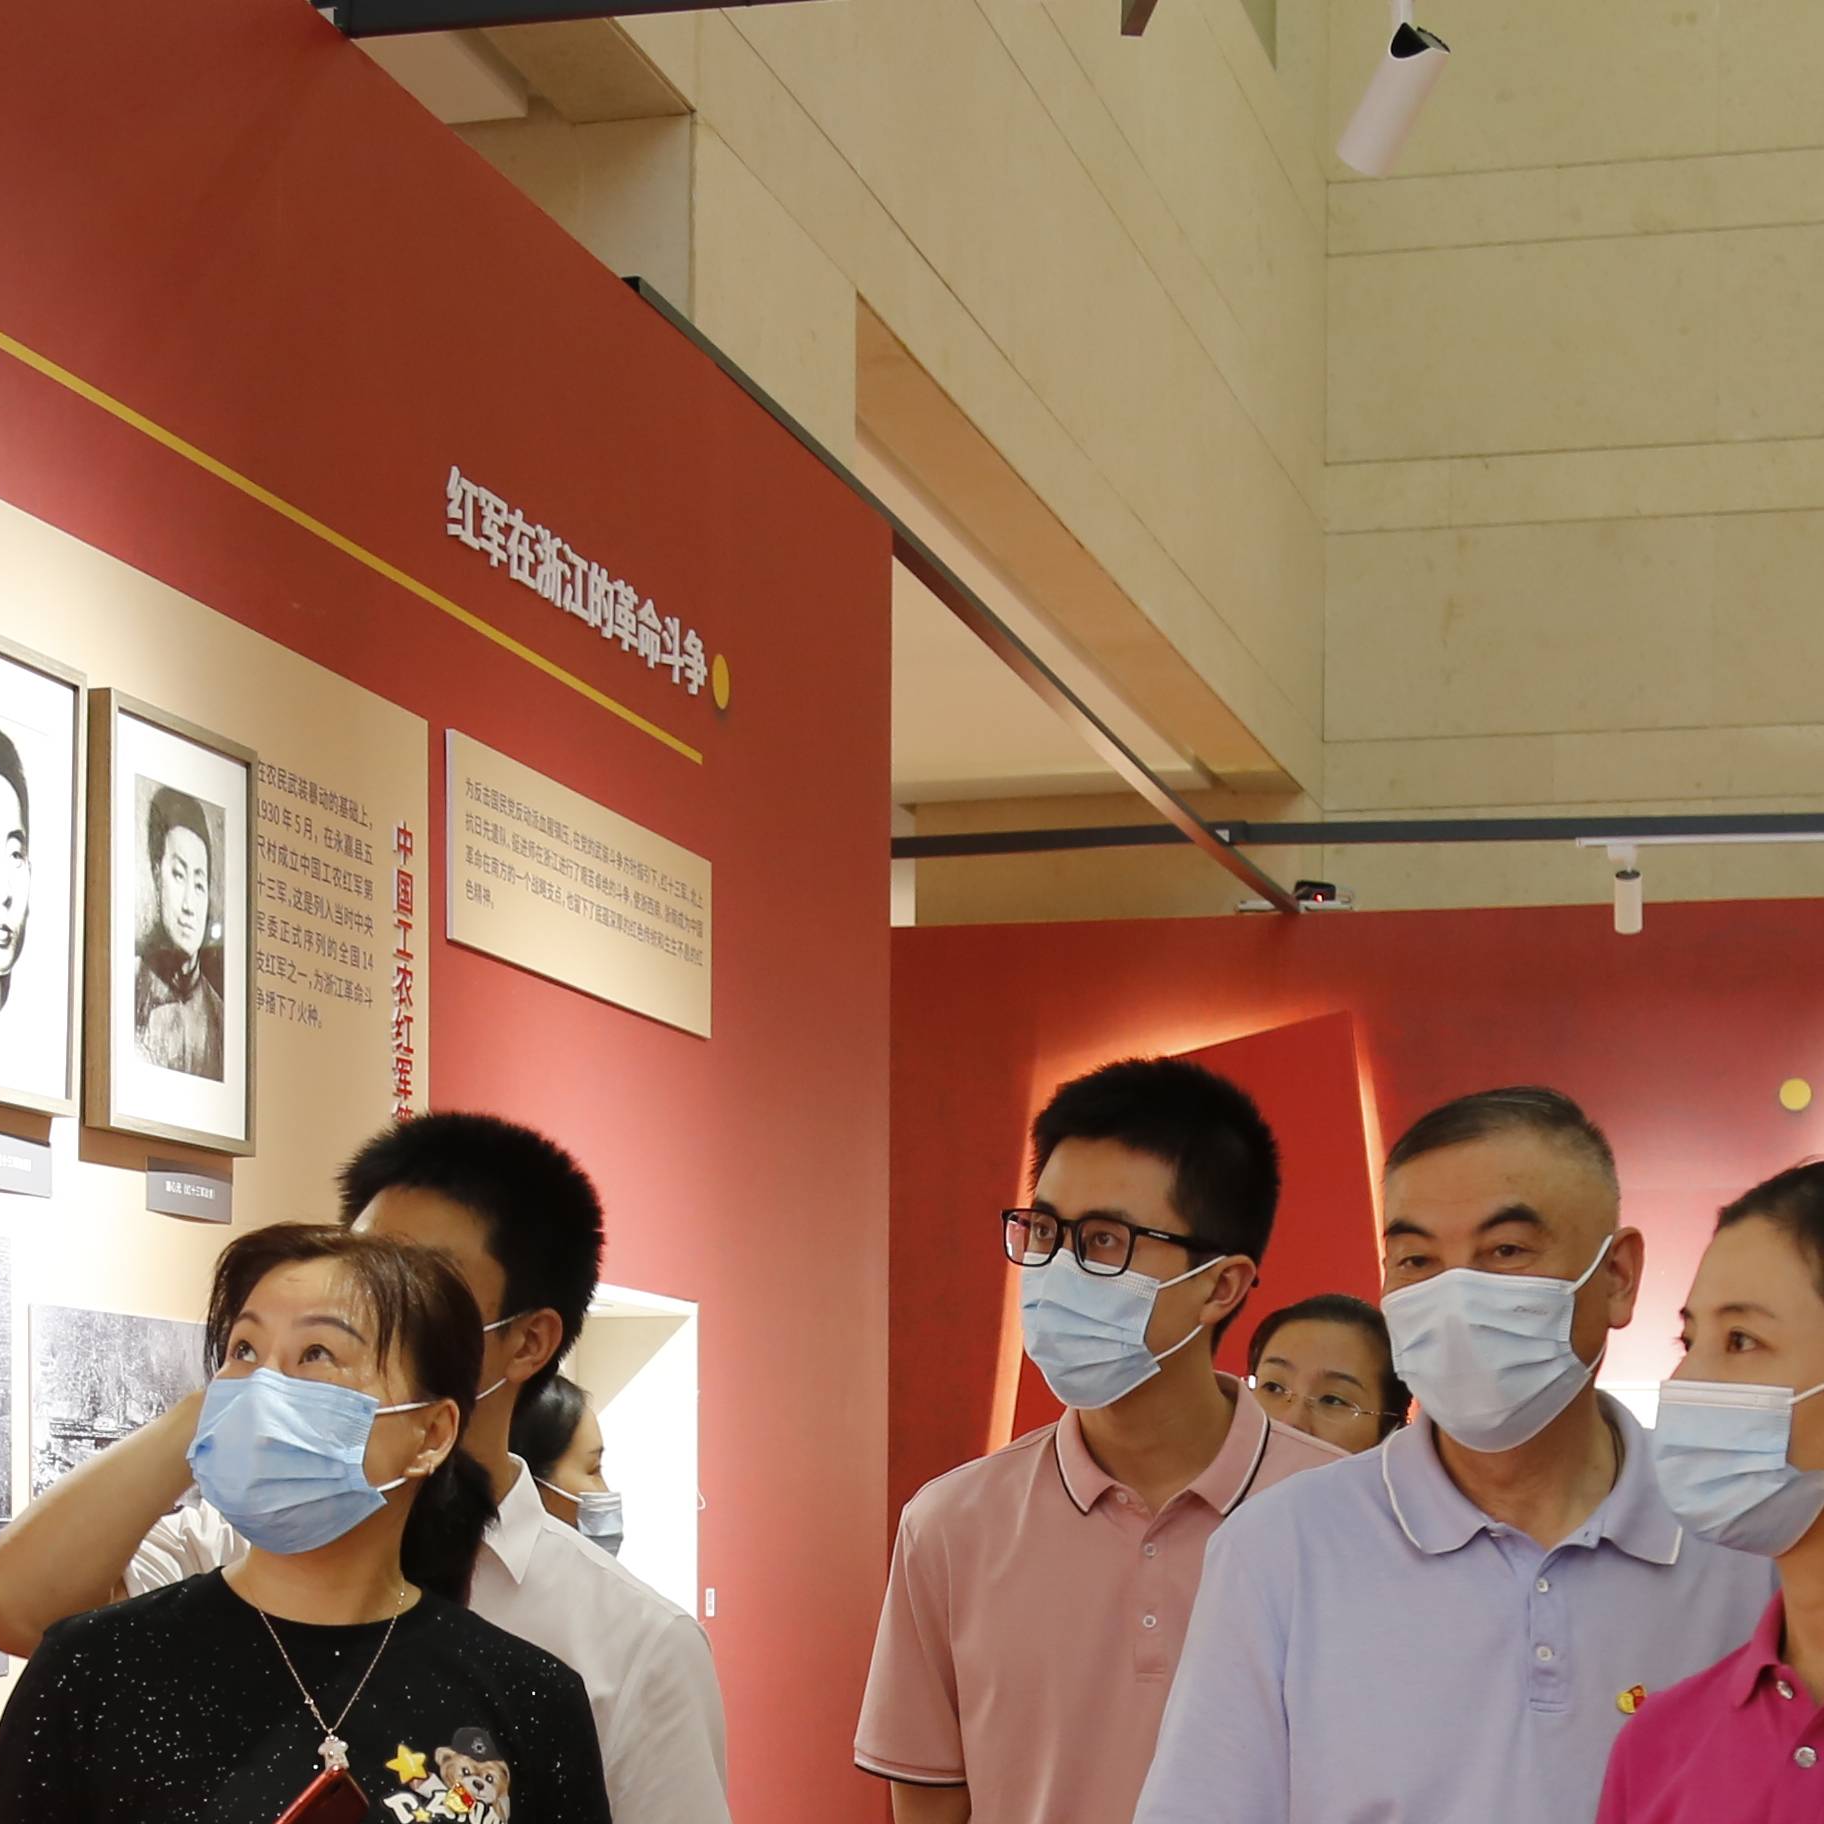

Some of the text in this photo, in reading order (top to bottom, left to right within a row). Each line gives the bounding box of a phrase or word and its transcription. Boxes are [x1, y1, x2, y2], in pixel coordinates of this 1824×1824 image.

[447, 465, 708, 695] 红军在浙江的革命斗争
